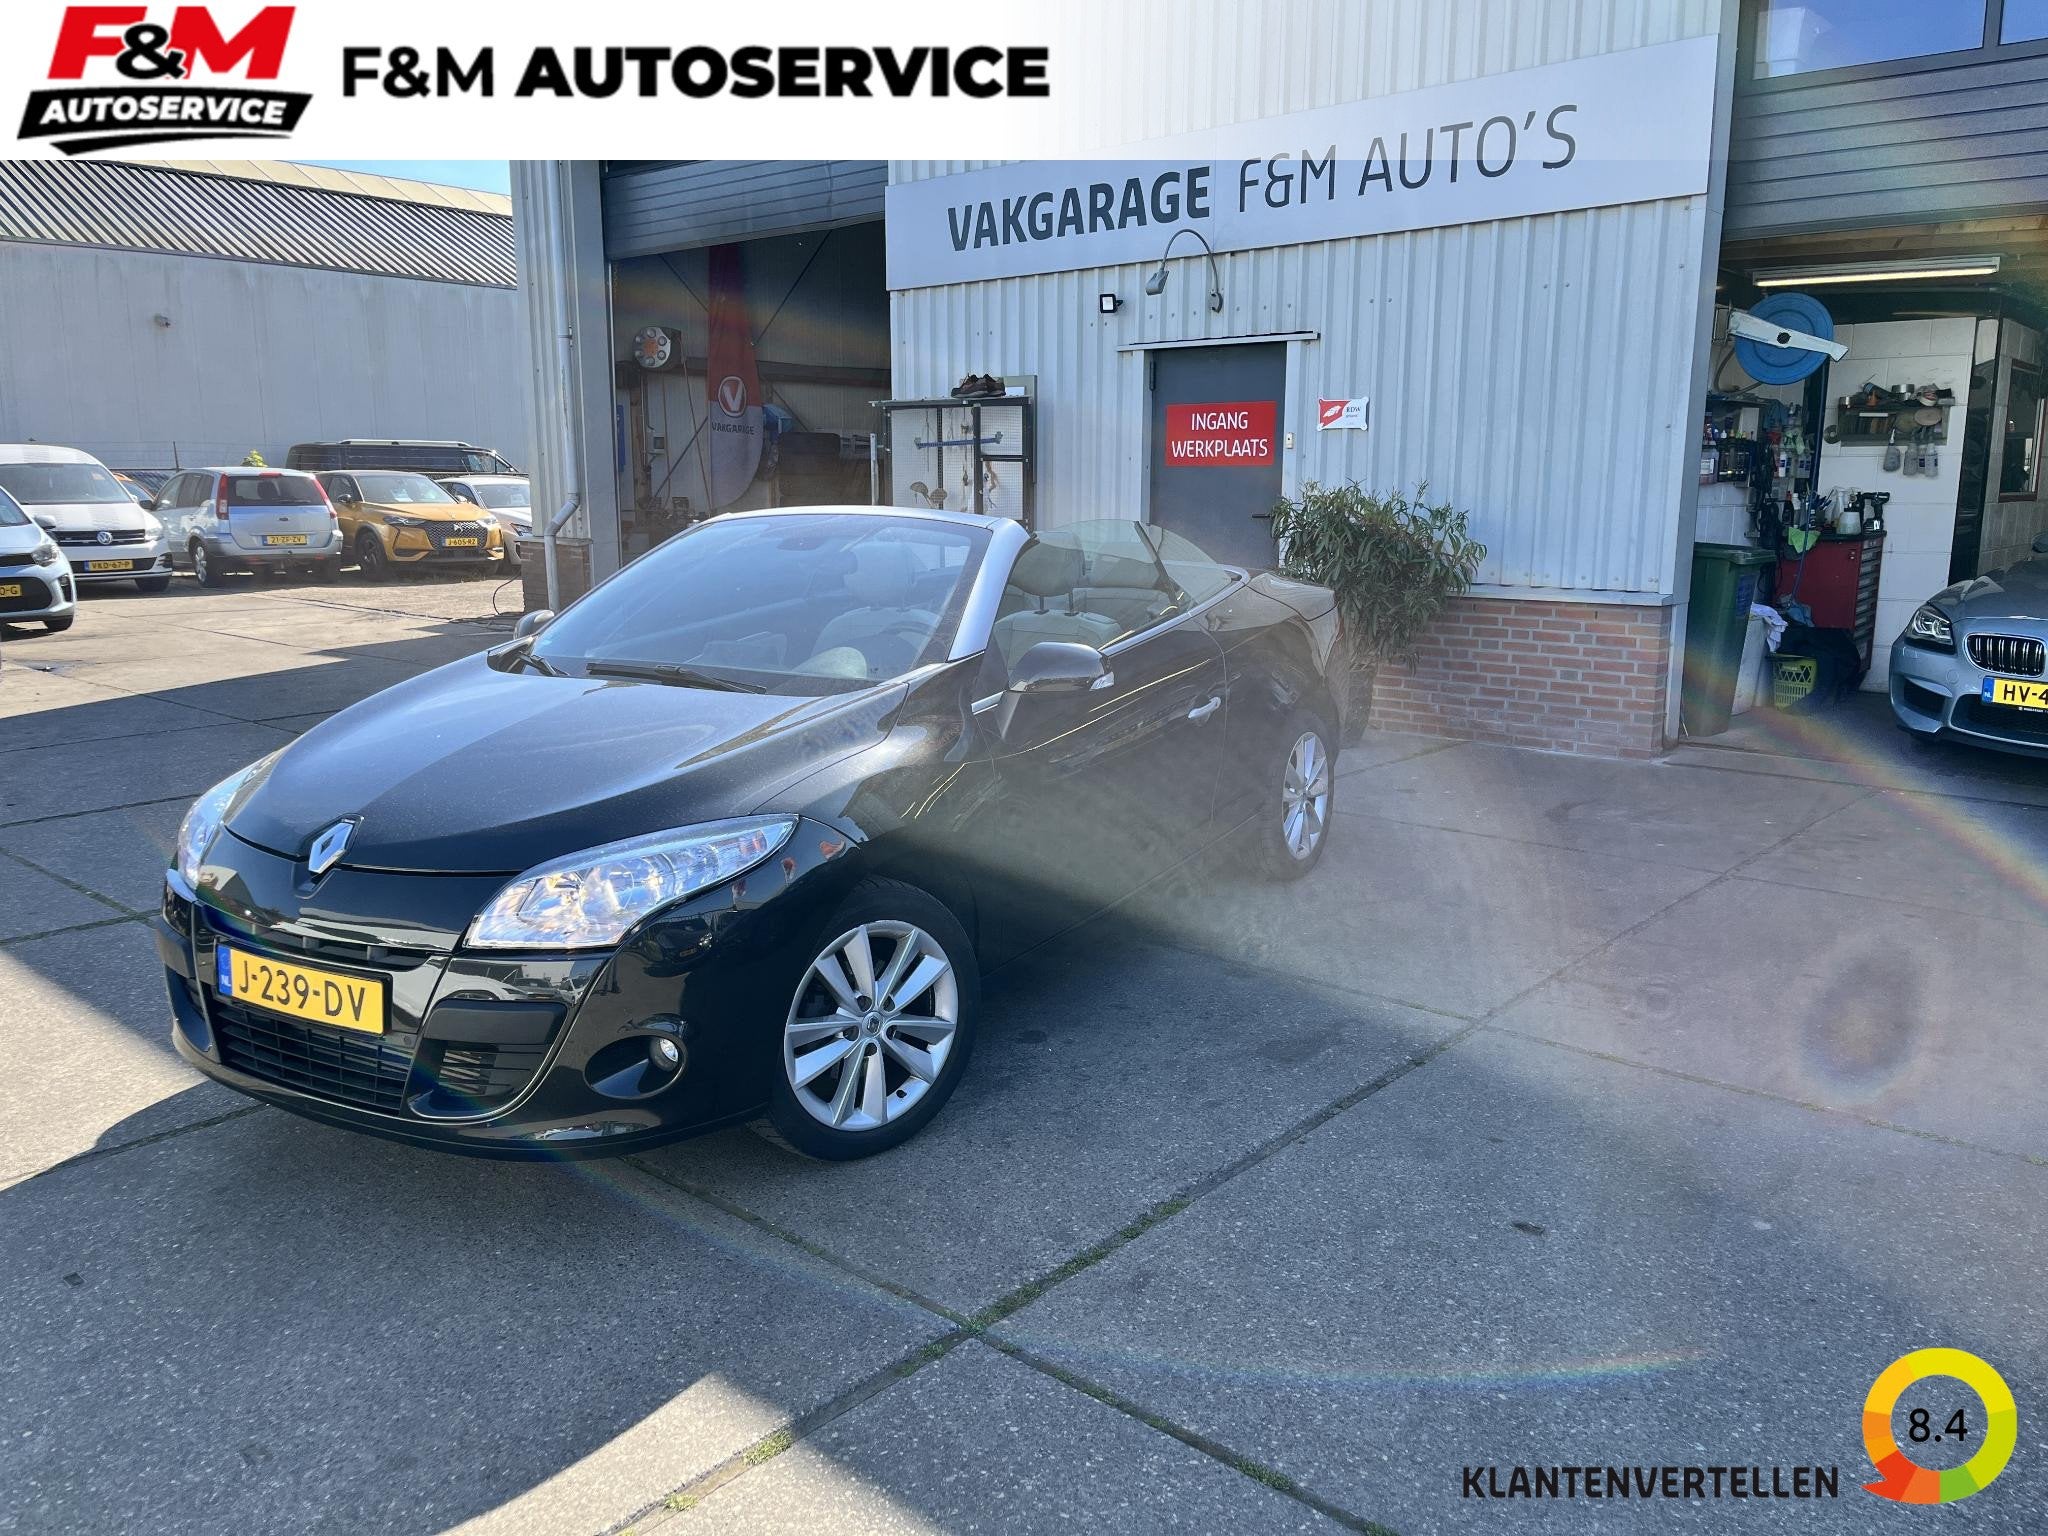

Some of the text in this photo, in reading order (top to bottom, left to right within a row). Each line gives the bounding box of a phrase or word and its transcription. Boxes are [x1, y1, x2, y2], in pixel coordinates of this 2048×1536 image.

[946, 104, 1578, 252] VAKGARAGE F&M AUTO'S
[1191, 412, 1248, 431] INGANG
[1171, 439, 1268, 458] WERKPLAATS
[239, 960, 366, 1021] J-239-DV
